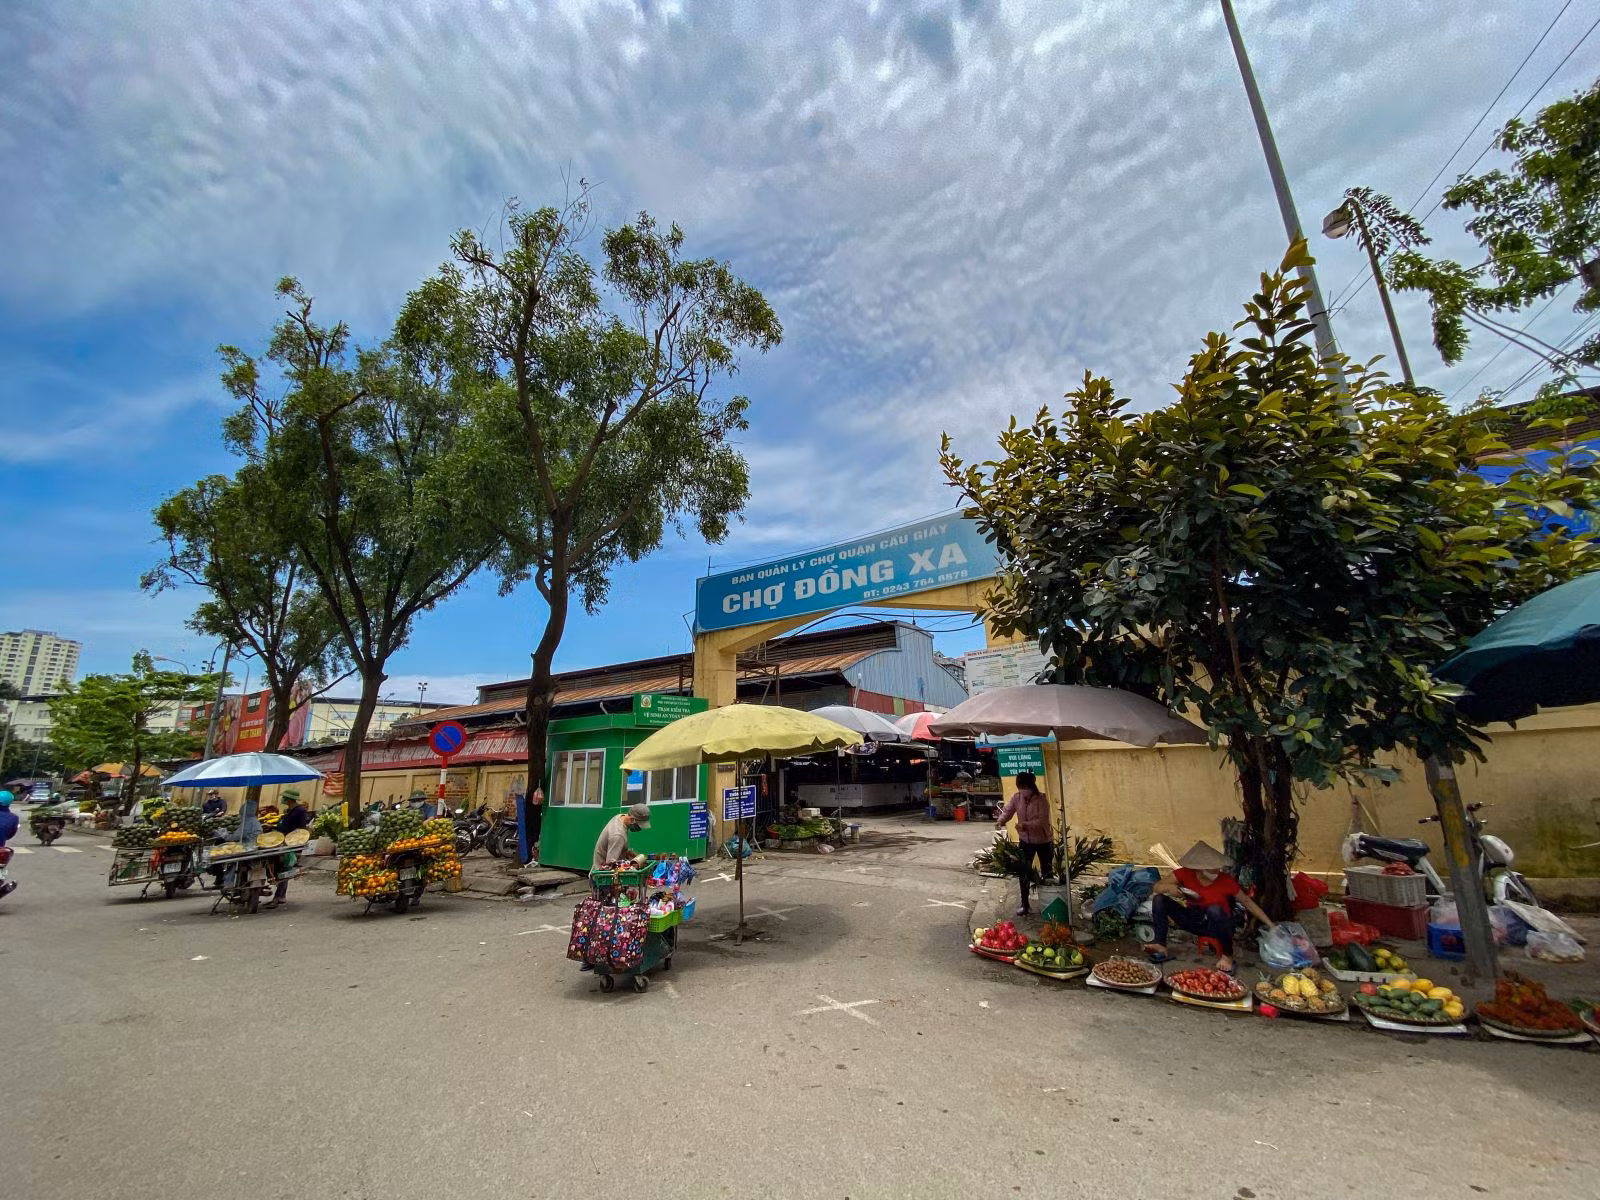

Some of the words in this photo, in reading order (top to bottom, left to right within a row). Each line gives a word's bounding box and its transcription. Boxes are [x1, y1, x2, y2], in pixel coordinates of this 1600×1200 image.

[722, 581, 786, 614] CHỢ
[794, 560, 894, 600] ĐỒNG
[908, 542, 968, 576] XA
[731, 573, 755, 585] BAN
[757, 564, 789, 579] QUẢN
[809, 552, 835, 567] CHỢ
[838, 543, 876, 560] QUẬN
